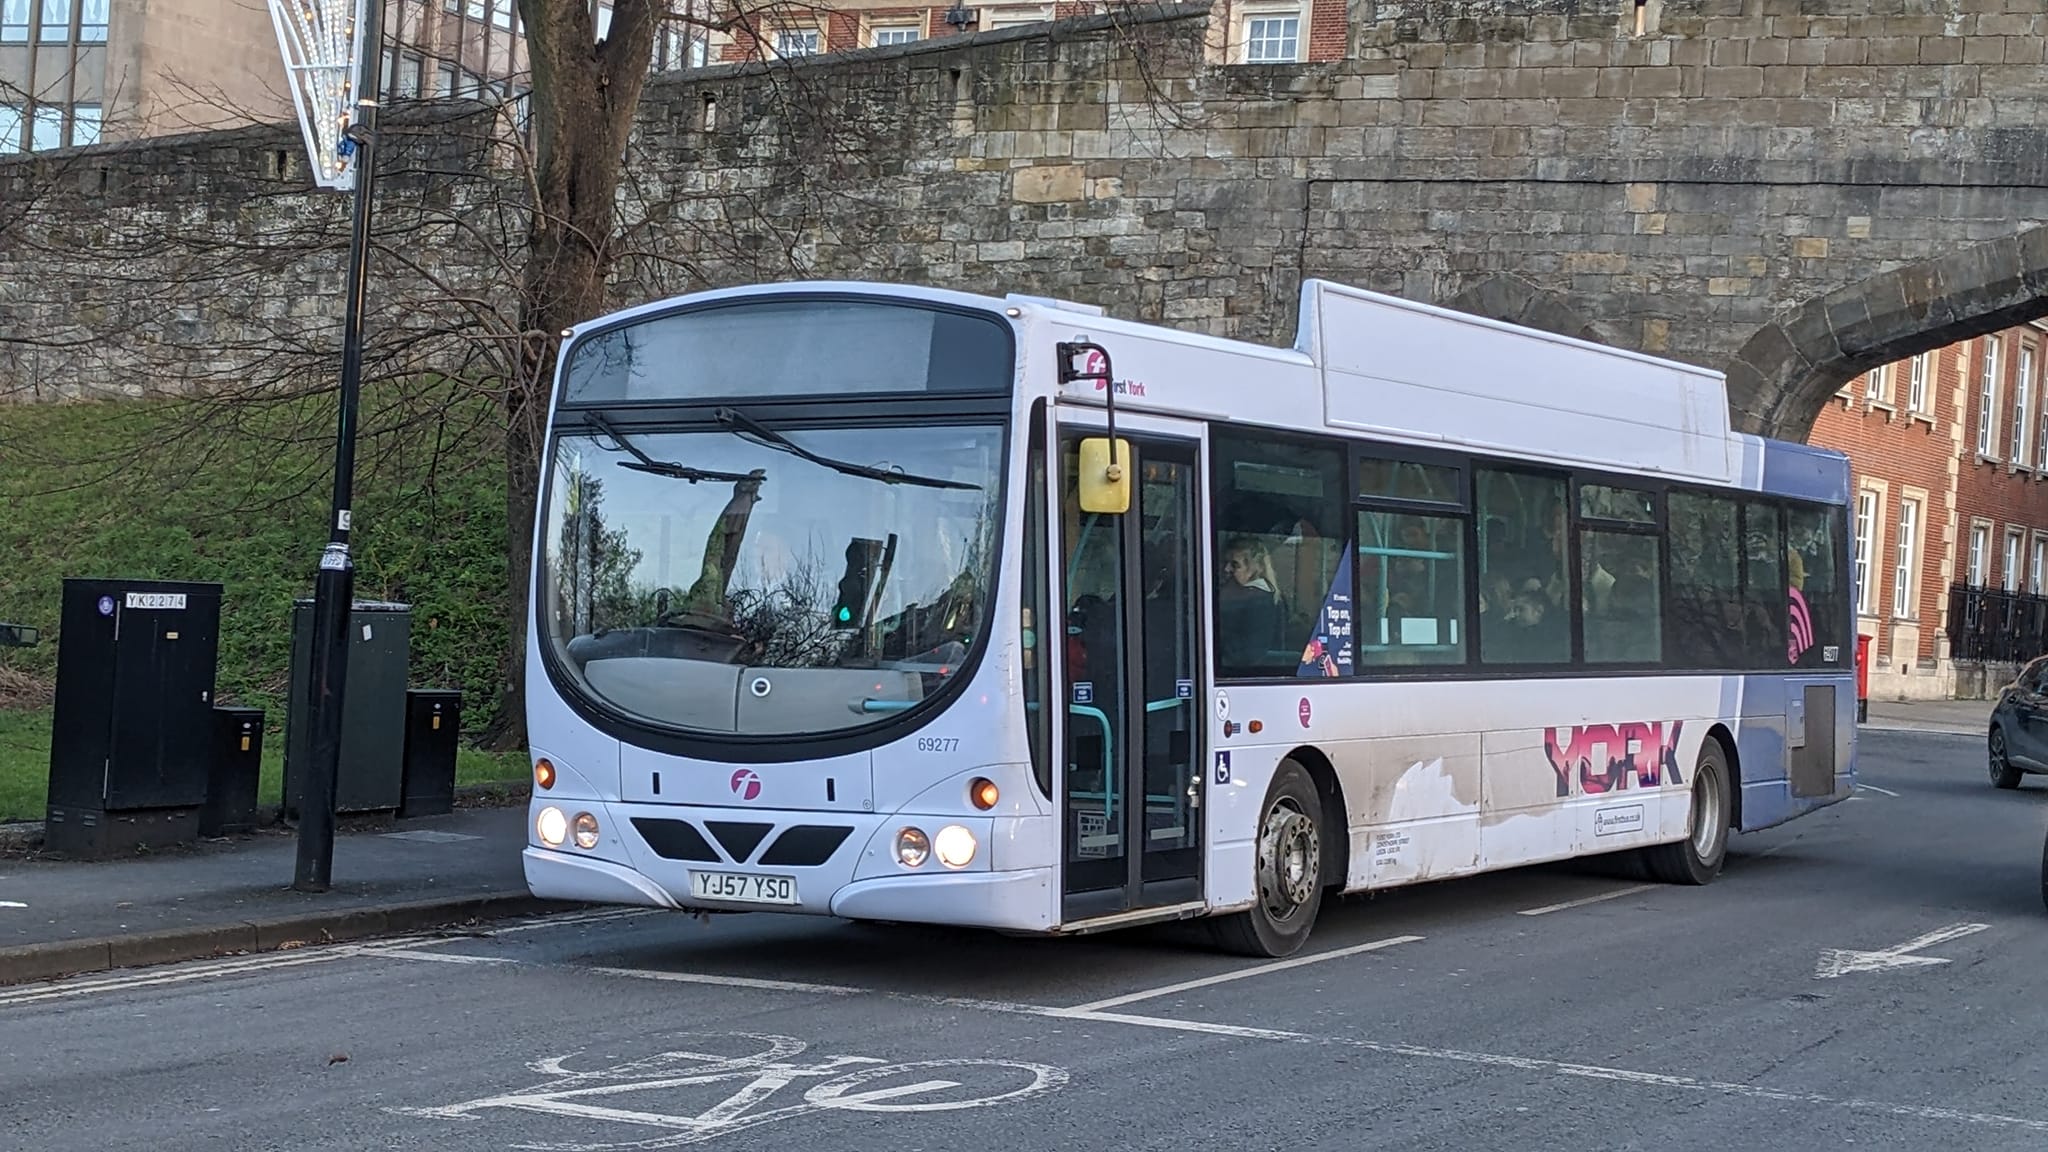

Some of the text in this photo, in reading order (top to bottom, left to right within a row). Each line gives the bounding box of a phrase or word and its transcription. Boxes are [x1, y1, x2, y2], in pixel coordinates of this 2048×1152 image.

[1128, 380, 1145, 397] York
[129, 595, 184, 607] YK2274
[1327, 606, 1340, 622] Tap
[1328, 622, 1351, 639] Tap off
[918, 737, 959, 751] 69277
[1544, 719, 1684, 798] YORK
[700, 873, 790, 899] YJ57 YSO
